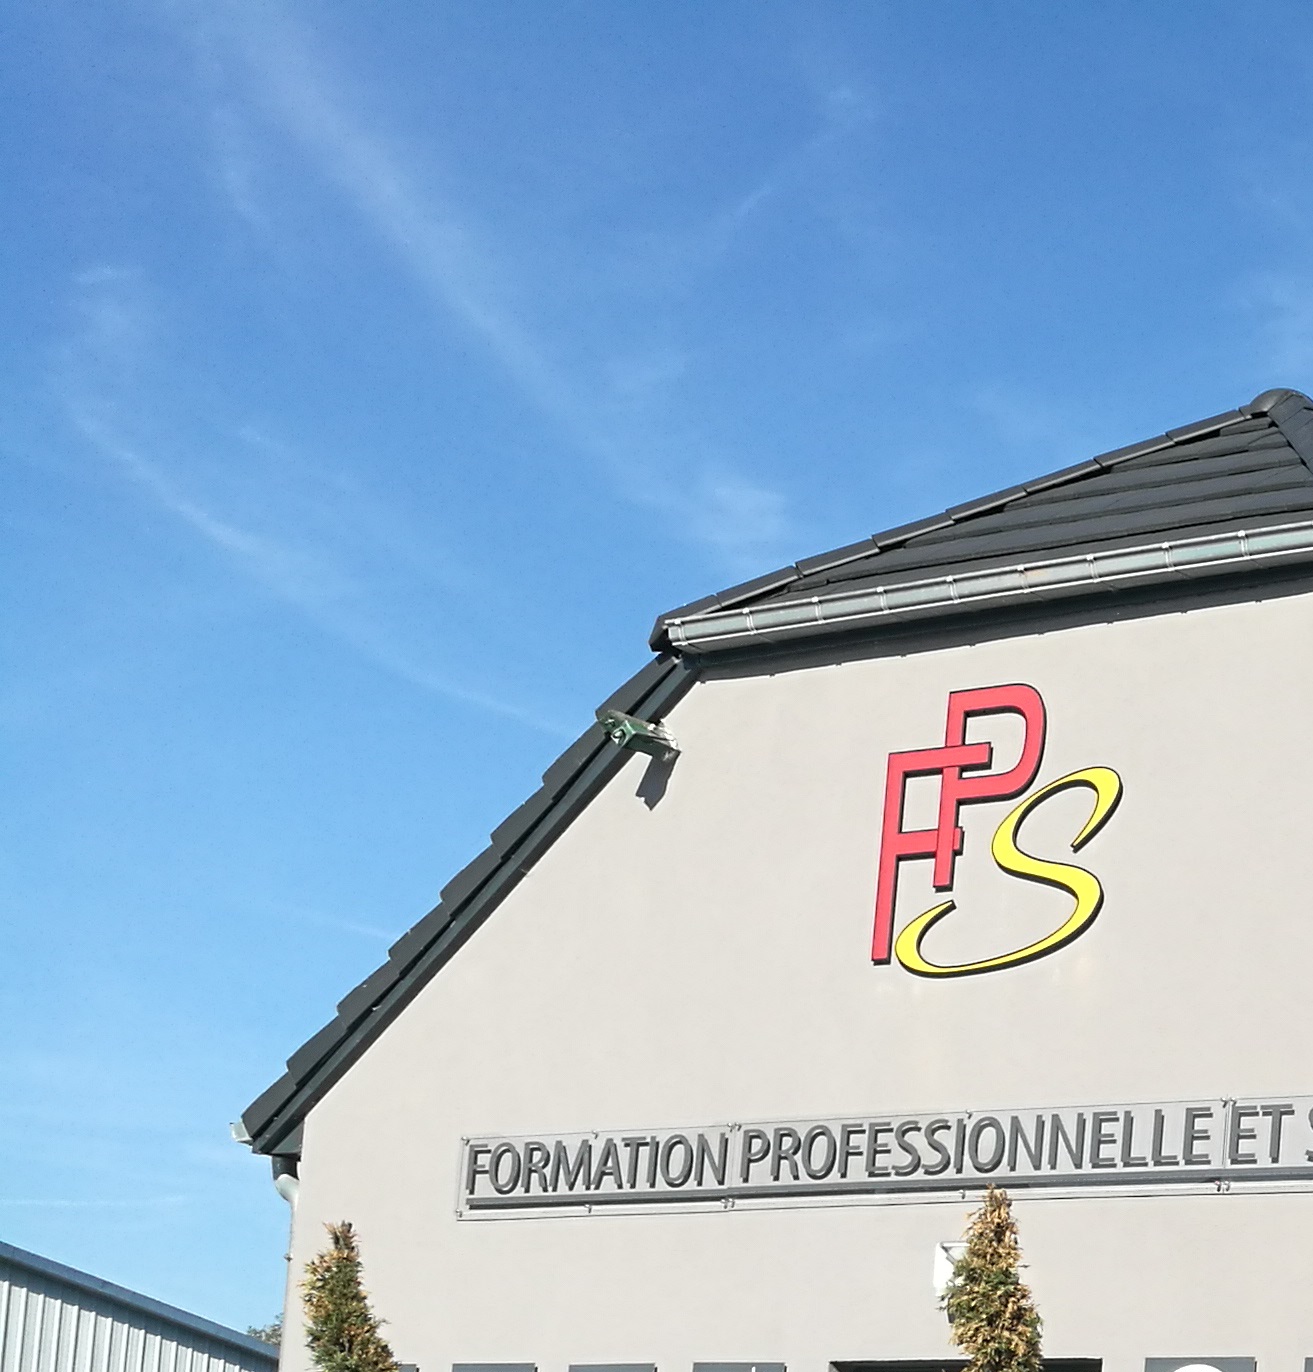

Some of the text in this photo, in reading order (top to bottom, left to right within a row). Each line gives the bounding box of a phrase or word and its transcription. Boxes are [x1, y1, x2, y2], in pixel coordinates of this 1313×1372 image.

[465, 1131, 727, 1195] FORMATION
[739, 1106, 1214, 1182] PROFESSIONNELLE
[1229, 1103, 1295, 1165] ET
